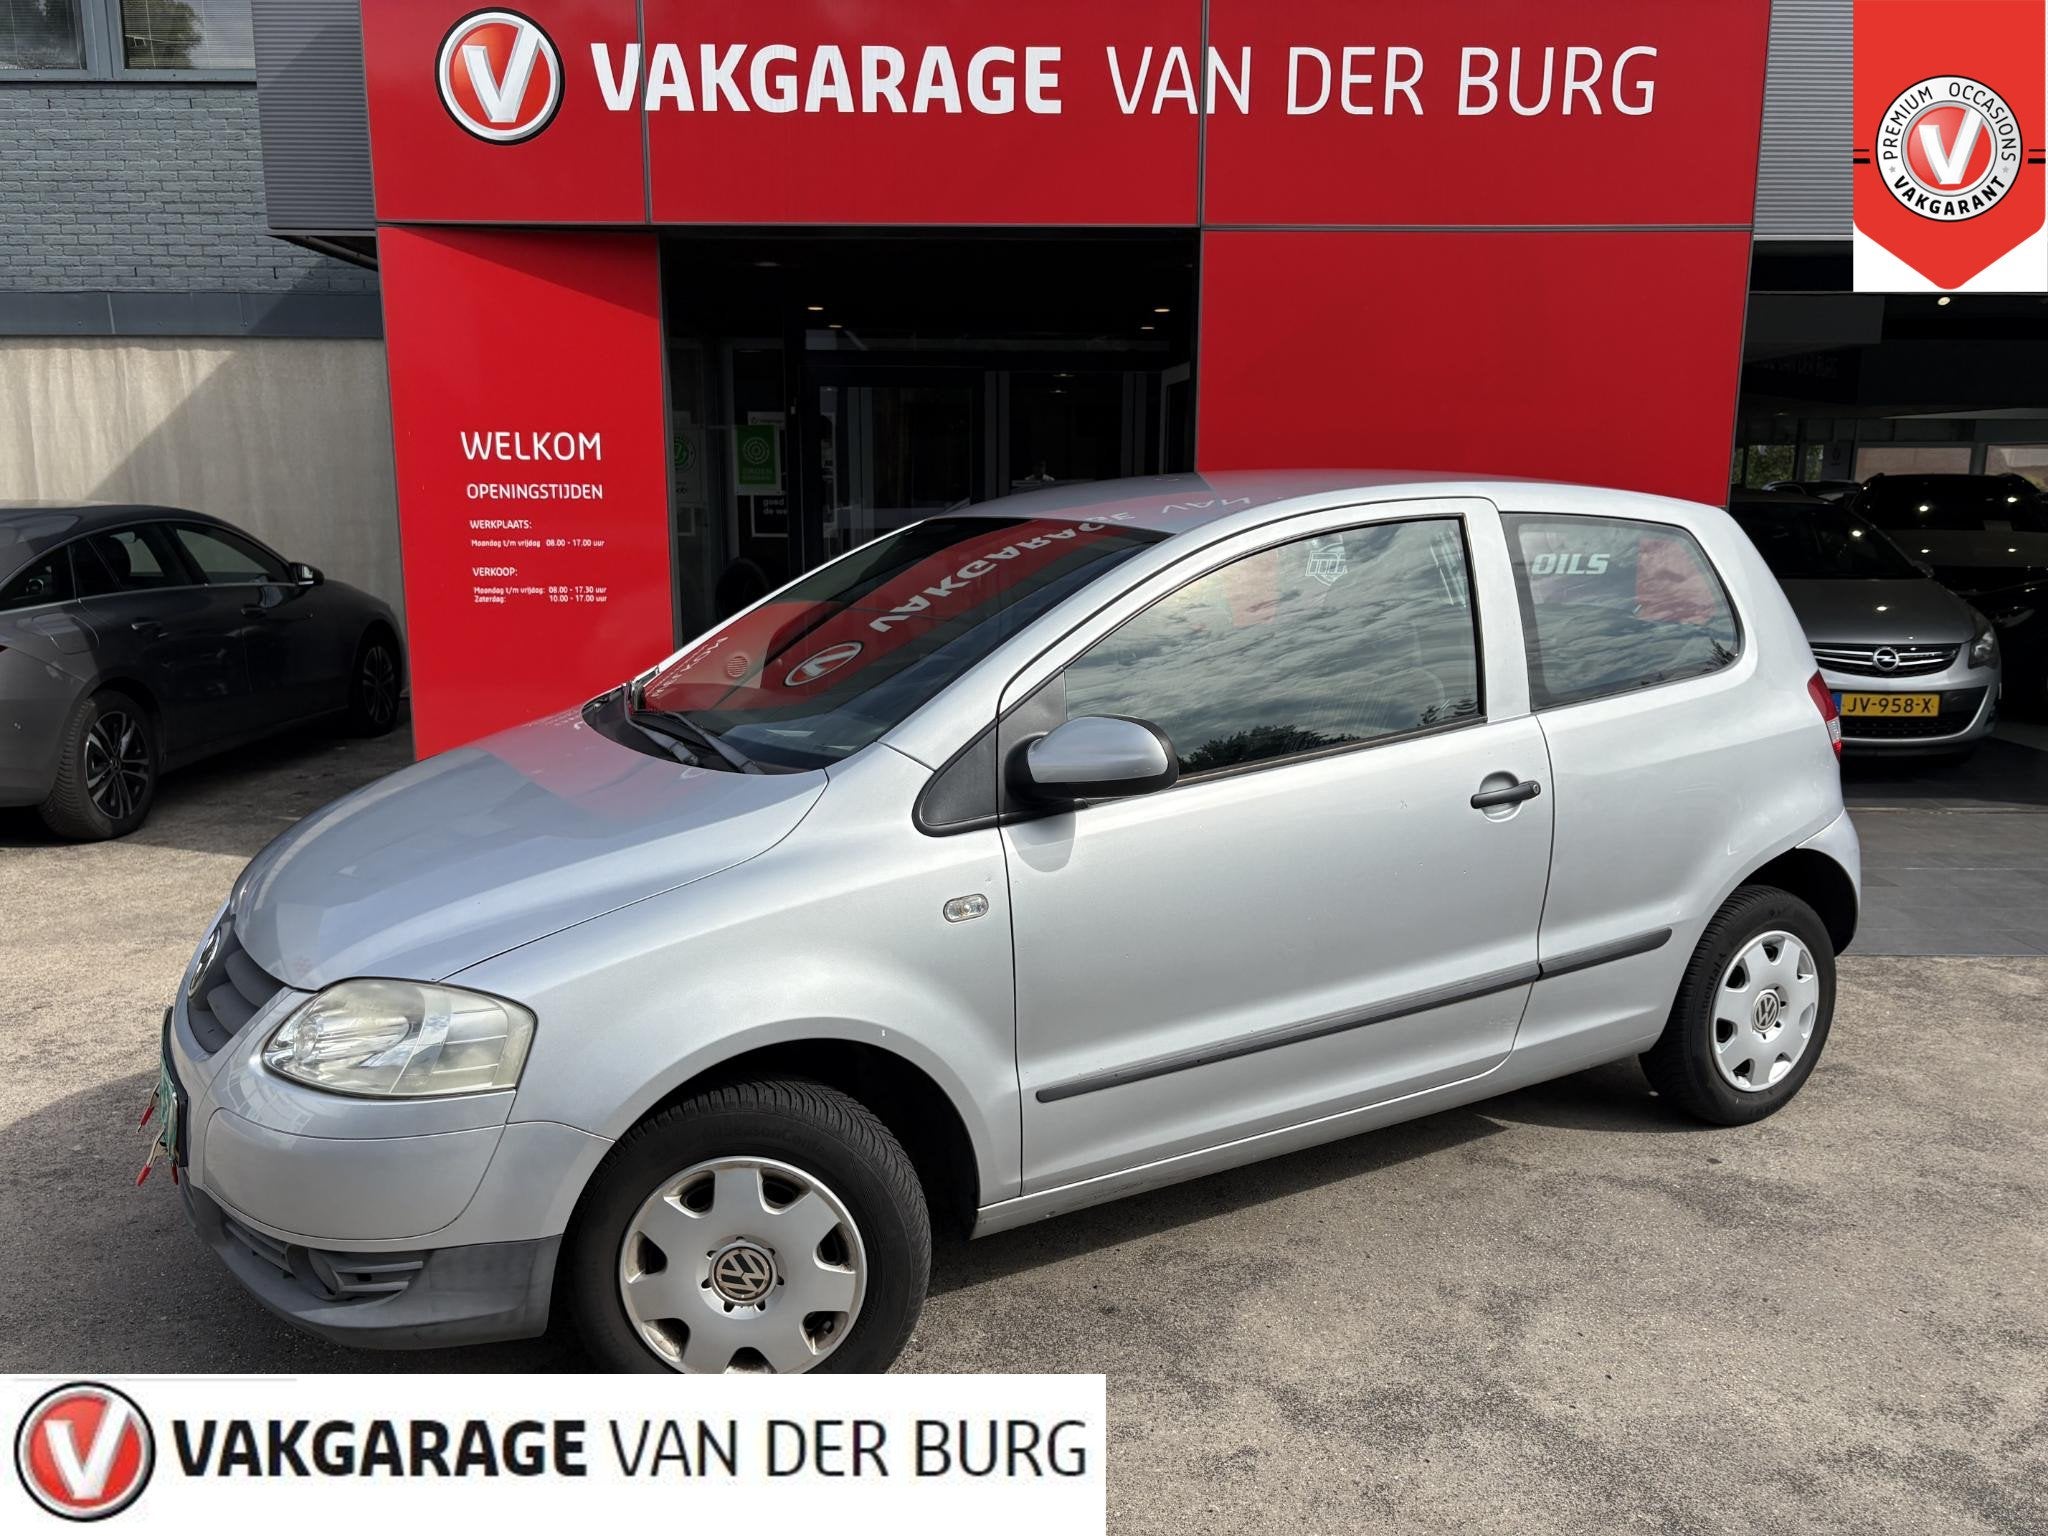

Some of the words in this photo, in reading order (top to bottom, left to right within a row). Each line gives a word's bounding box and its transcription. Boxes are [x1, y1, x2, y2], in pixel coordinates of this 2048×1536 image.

[590, 42, 1062, 115] VAKGARAGE
[1106, 46, 1251, 115] VAN
[1286, 46, 1424, 115] DER
[1458, 45, 1657, 116] BURG
[460, 431, 602, 461] WELKOM
[466, 483, 603, 500] OPENINGSTIJDEN
[469, 519, 533, 530] WERKPLAATS:
[472, 566, 518, 577] VERKOOP:
[1530, 553, 1610, 575] OILS
[1847, 697, 1932, 713] JV-958-X
